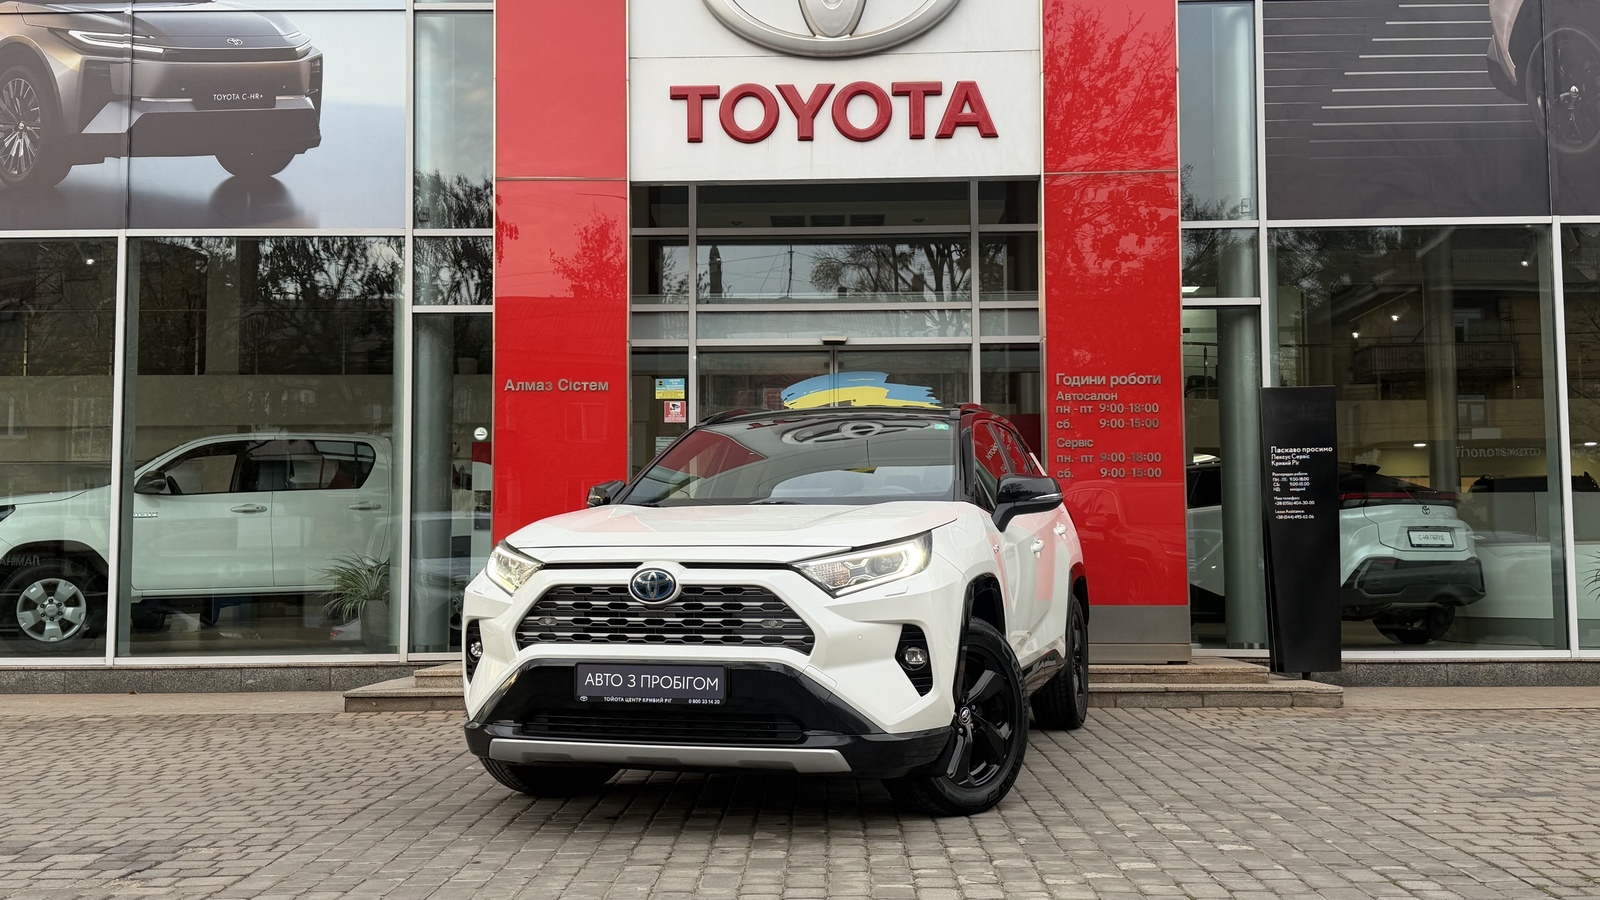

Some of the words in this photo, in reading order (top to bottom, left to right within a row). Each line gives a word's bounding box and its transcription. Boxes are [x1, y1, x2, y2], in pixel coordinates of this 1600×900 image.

[213, 93, 240, 101] TOYOTA
[241, 92, 263, 101] C-HR+
[669, 80, 999, 144] TOYOTA
[504, 378, 553, 391] Алмаз
[557, 378, 609, 391] Сістем
[1055, 373, 1107, 387] Години
[1110, 372, 1162, 388] роботи
[1055, 391, 1118, 401] Автосалон
[1099, 402, 1159, 413] 9:00-18:00
[1056, 419, 1073, 429] сб.
[1099, 418, 1159, 429] 9:00-15:00
[1056, 437, 1094, 449] Сервіс
[1100, 452, 1162, 463] 9:00-18:00
[1057, 468, 1074, 478] сб.
[1100, 467, 1162, 478] 9:00-15:00
[584, 672, 623, 687] АВТО
[627, 674, 637, 688] З
[640, 674, 720, 691] ПРОБІГОМ
